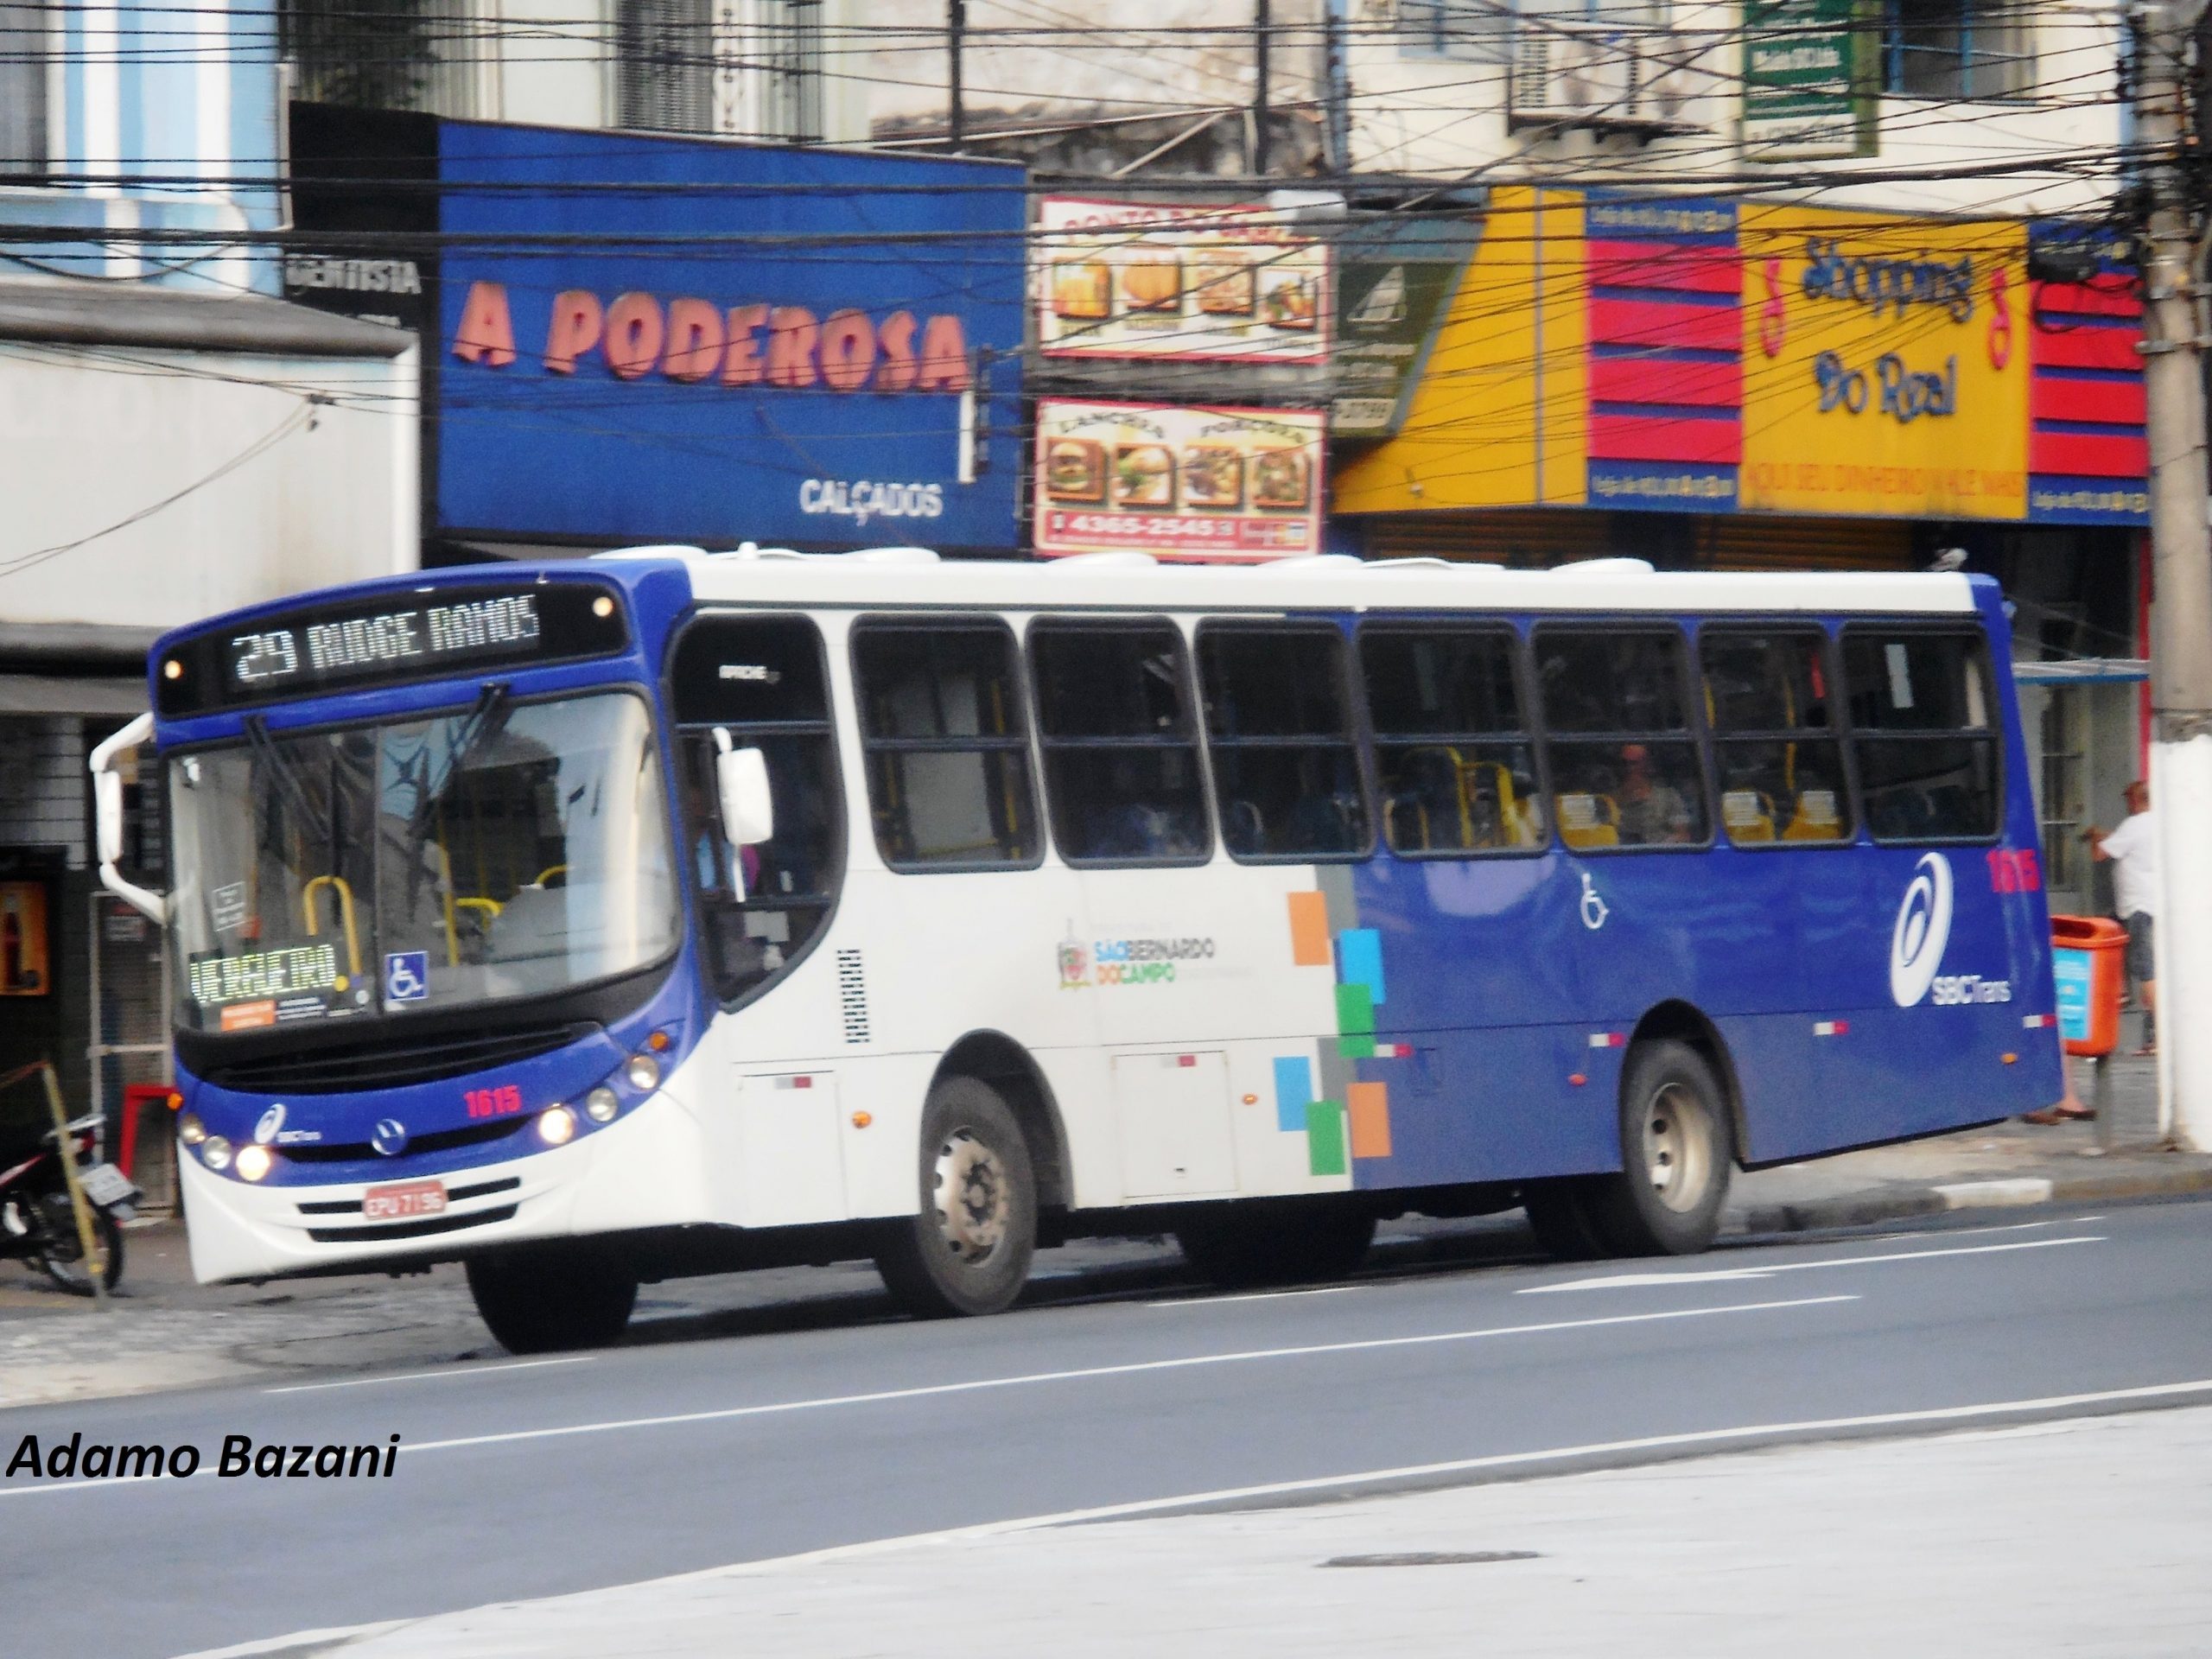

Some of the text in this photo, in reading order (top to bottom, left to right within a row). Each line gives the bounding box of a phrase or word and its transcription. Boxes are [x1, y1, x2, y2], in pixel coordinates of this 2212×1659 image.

[452, 280, 971, 392] A PODEROSA
[1815, 350, 1958, 423] Do Real
[800, 479, 944, 526] CALÇADOS
[232, 594, 540, 684] 29 RUDGE RAMOS
[463, 1085, 522, 1118] 1615
